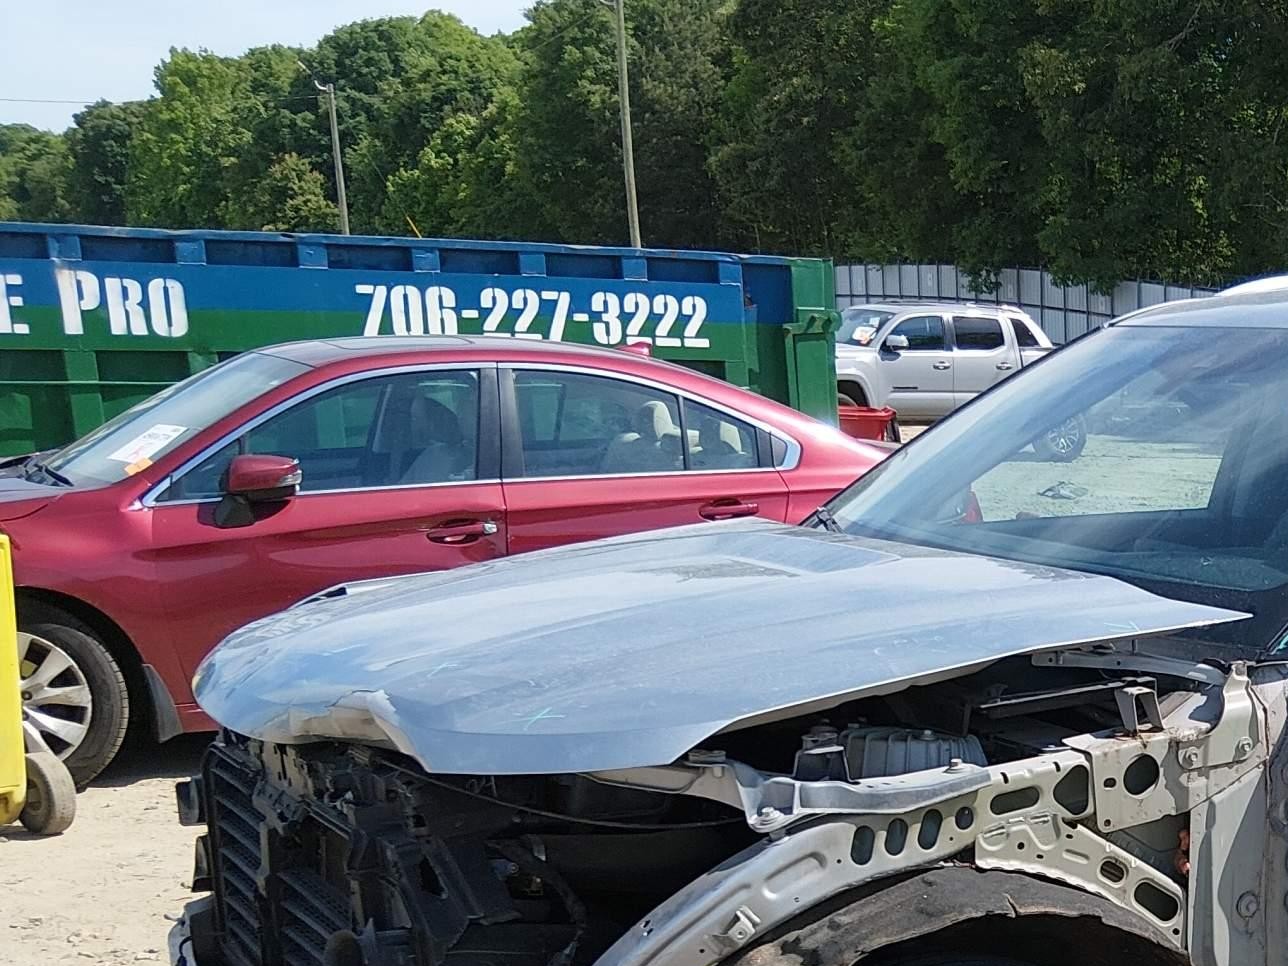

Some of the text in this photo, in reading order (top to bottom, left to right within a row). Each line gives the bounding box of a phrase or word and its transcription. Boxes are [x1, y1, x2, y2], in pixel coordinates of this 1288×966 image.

[0, 269, 188, 337] E PRO
[355, 284, 710, 348] 706-227-3222
